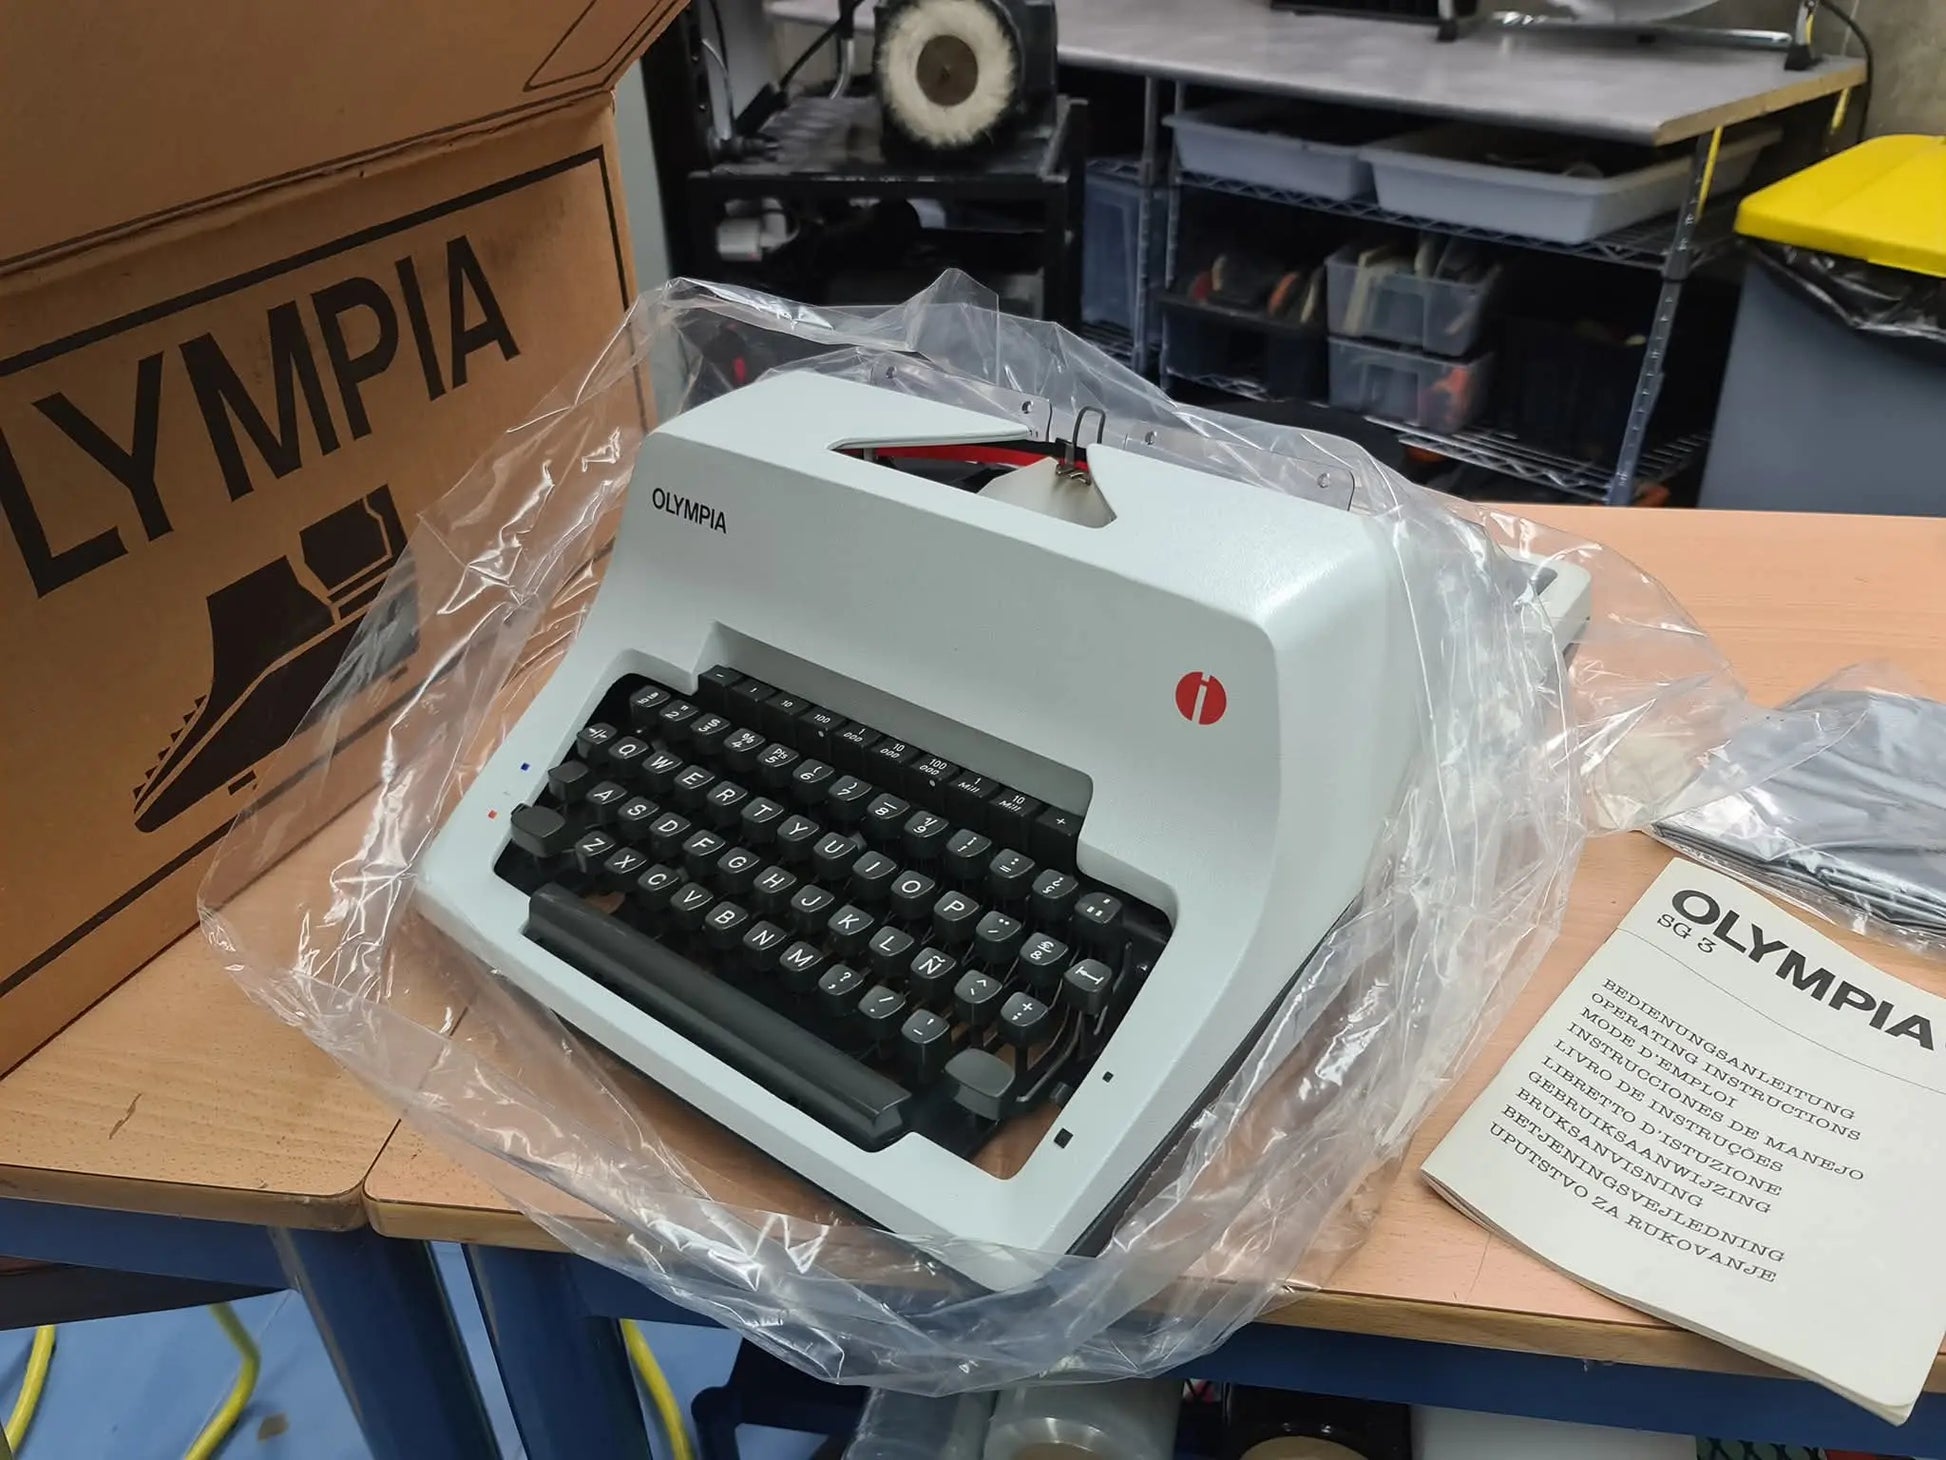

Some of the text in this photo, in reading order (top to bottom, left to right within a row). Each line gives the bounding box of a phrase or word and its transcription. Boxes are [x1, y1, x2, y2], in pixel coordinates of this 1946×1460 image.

[652, 487, 727, 534] OLYMPIA
[781, 700, 793, 708] 10
[665, 711, 680, 719] 2
[814, 713, 831, 724] 100
[731, 740, 743, 748] 4
[741, 733, 755, 744] %
[843, 732, 863, 743] 000
[618, 744, 637, 756] Q
[772, 748, 788, 760] Pts
[880, 748, 900, 759] 000
[892, 743, 906, 752] 10
[650, 755, 674, 769] W
[765, 755, 779, 764] 5
[928, 758, 948, 770] 100
[800, 772, 815, 780] 6
[919, 764, 940, 776] 000
[682, 771, 704, 785] E
[837, 788, 851, 796] 7
[957, 781, 980, 793] Mill
[593, 789, 614, 801] A
[716, 788, 736, 802] R
[1012, 795, 1026, 805] 10
[627, 804, 647, 816] S
[753, 804, 773, 817] T
[875, 807, 889, 816] 8
[999, 800, 1022, 812] Mill
[657, 819, 679, 832] D
[789, 822, 809, 835] Y
[913, 825, 927, 834] 9
[582, 837, 606, 851] Z
[691, 837, 715, 849] F
[824, 839, 845, 853] U
[614, 854, 636, 869] X
[727, 856, 747, 869] G
[865, 861, 881, 873] I
[647, 873, 667, 886] C
[762, 873, 785, 889] H
[901, 880, 921, 893] O
[683, 890, 703, 904] V
[801, 895, 822, 906] J
[943, 899, 965, 913] P
[714, 910, 736, 924] B
[837, 914, 860, 930] K
[752, 929, 775, 946] N
[1656, 913, 1718, 953] SG 3
[879, 935, 895, 952] L
[787, 948, 814, 967] M
[1030, 950, 1043, 960] &
[918, 955, 946, 975] Ñ
[1671, 889, 1935, 1051] OLYMPIA
[839, 971, 852, 982] ?
[1601, 978, 1856, 1120] BEDIENUNGSANLEITUNG
[1580, 1007, 1739, 1109] MODE D'EMPLOI
[1591, 991, 1862, 1141] OPERATING INSTRUCTIONS
[1552, 1037, 1784, 1173] LIVRO DE INSTRUÇÕES
[1567, 1021, 1865, 1181] INSTRUCCIONES DE MANEJO
[1541, 1055, 1783, 1197] LIBRETTO D'ISTUZIONE
[1514, 1086, 1704, 1209] BRUKSANVISNING
[1527, 1070, 1772, 1215] GEBRUIKSAANWIJZING
[1500, 1103, 1786, 1263] BETJENINGSVEJLEDNING
[1488, 1121, 1778, 1284] UPUTSTVO ZA RUKOVANJE
